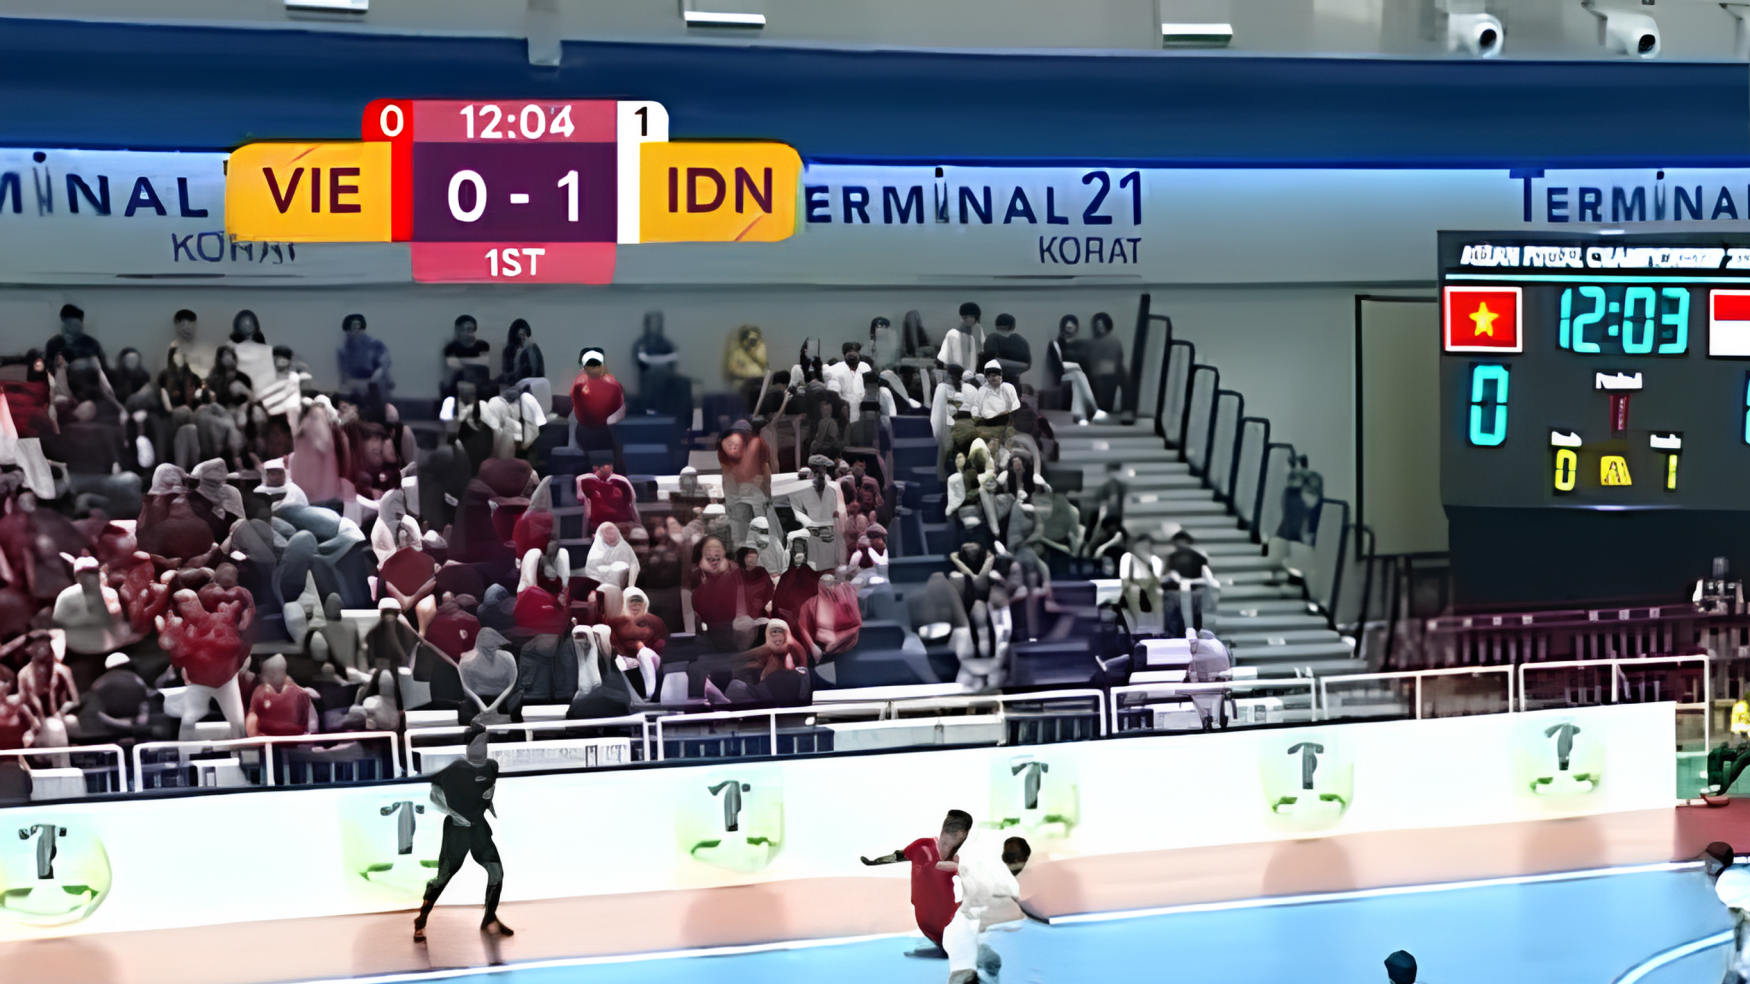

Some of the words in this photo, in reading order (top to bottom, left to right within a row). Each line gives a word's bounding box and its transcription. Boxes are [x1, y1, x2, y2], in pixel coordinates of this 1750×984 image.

[1559, 286, 1691, 355] 12:03
[1469, 364, 1510, 447] 0
[1554, 448, 1578, 492] 0
